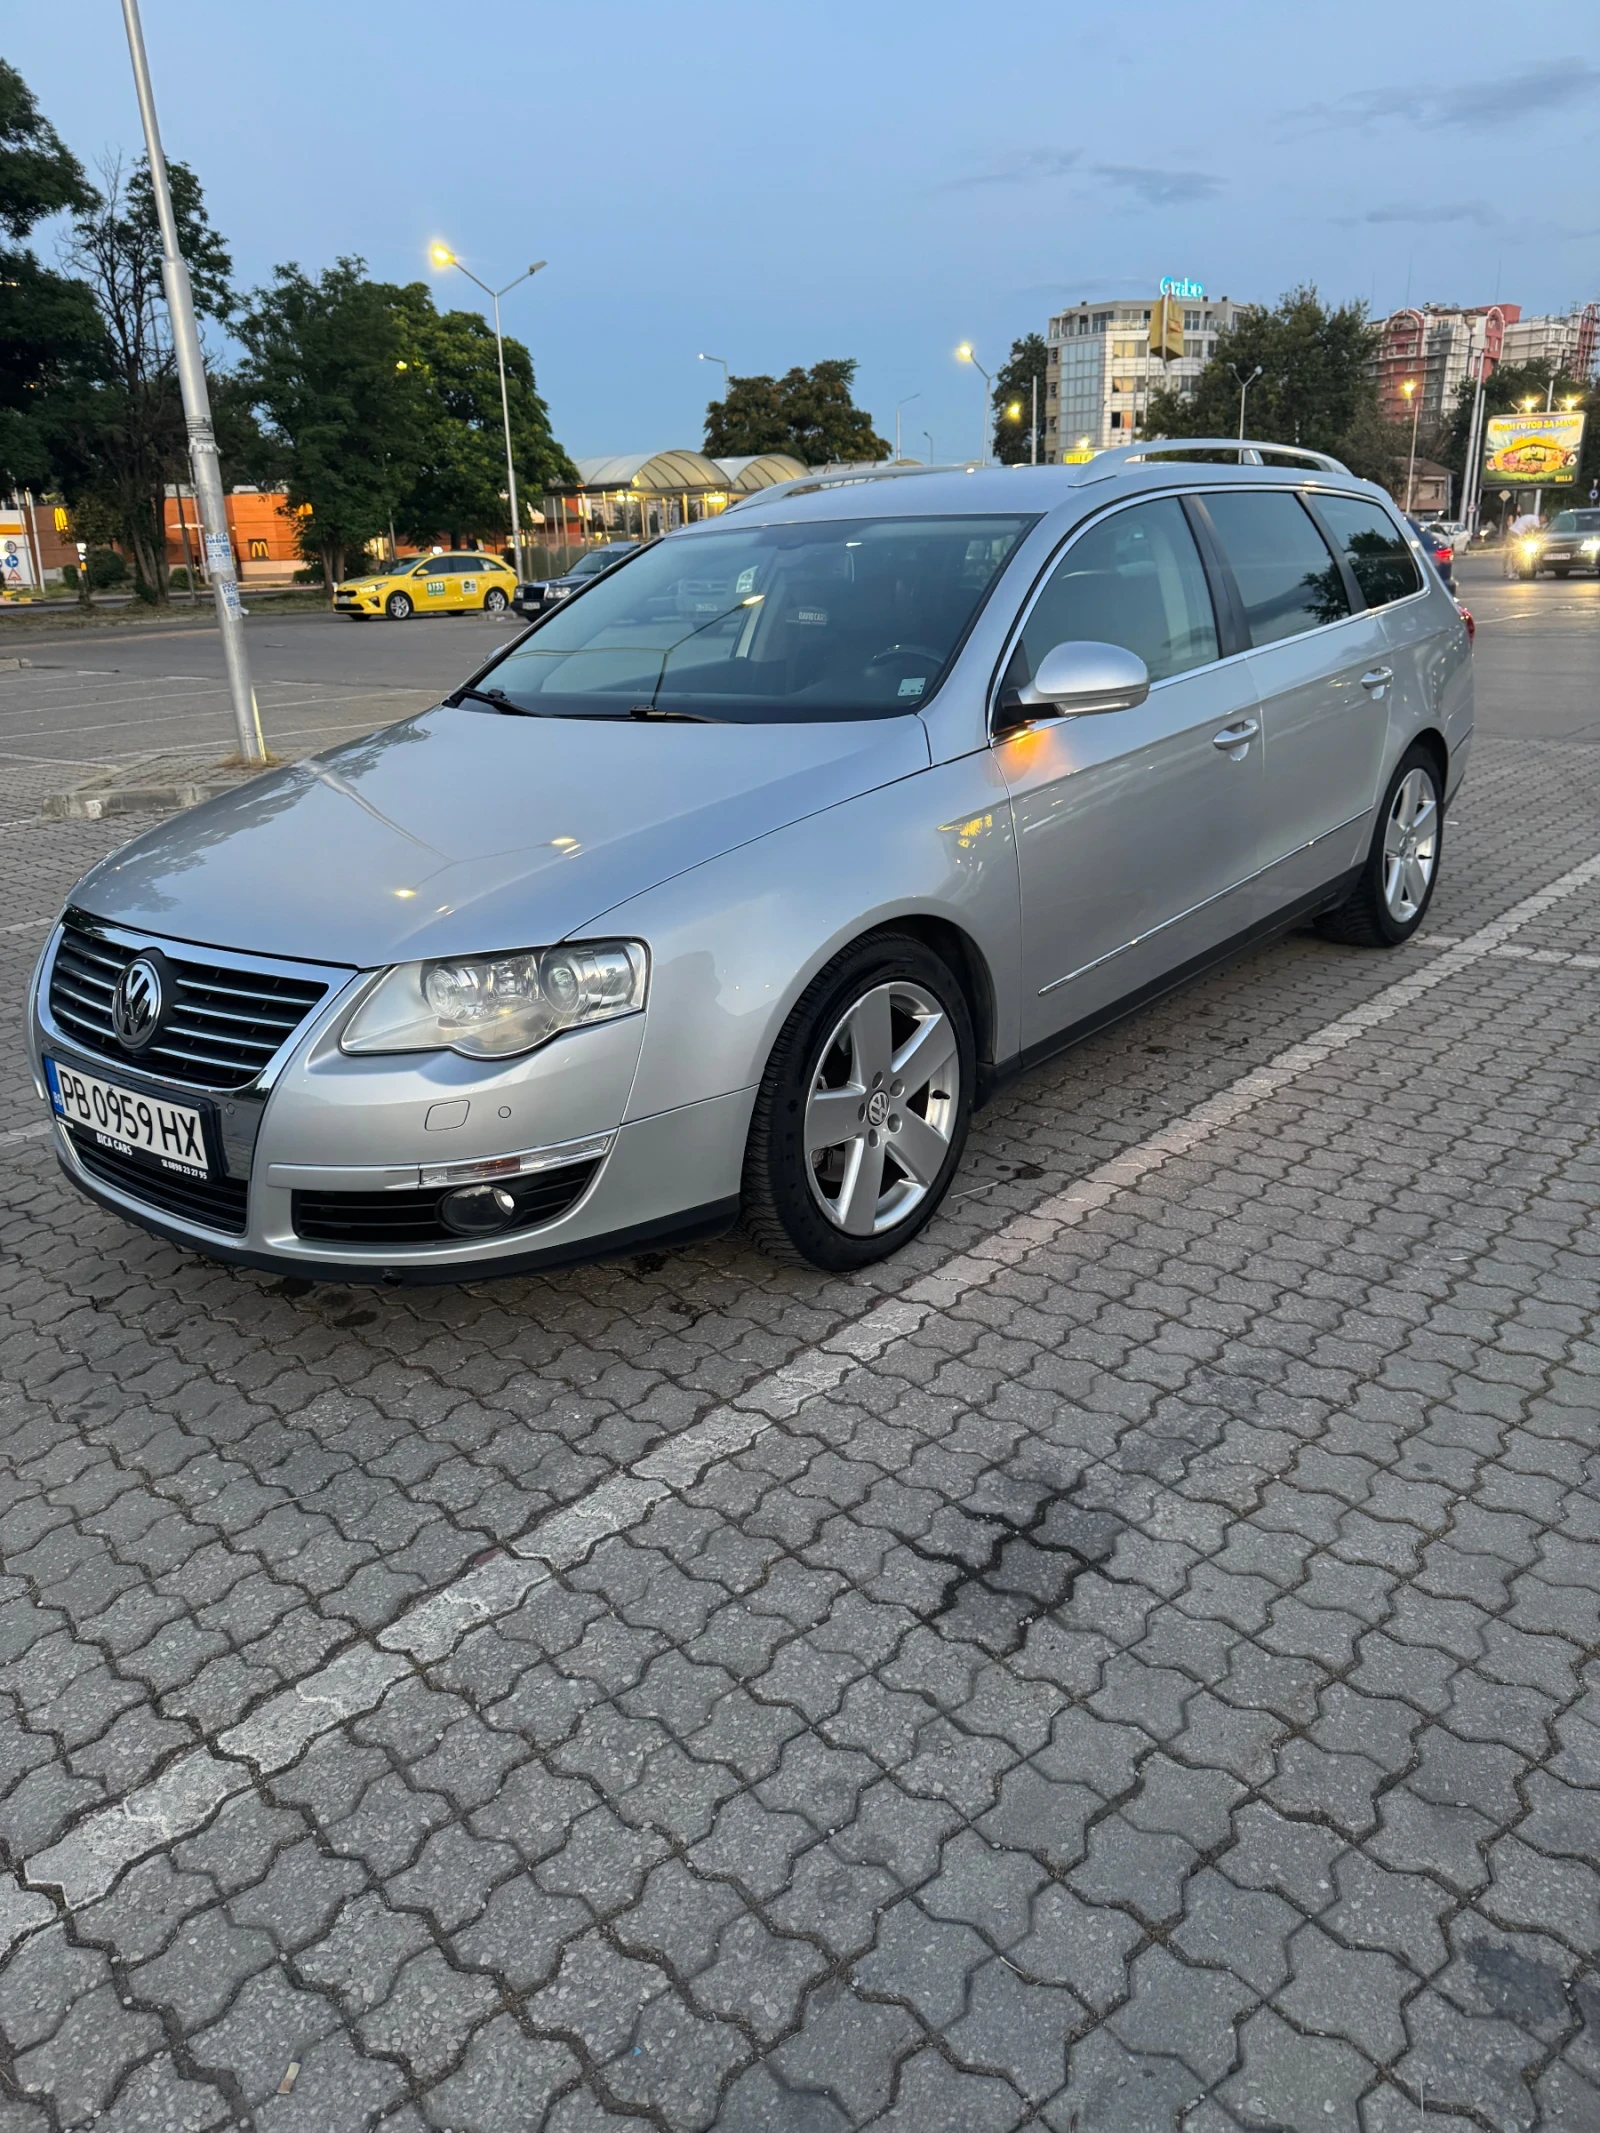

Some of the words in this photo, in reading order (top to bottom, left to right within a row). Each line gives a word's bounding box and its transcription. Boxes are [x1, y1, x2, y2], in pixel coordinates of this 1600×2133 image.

[1517, 420, 1542, 430] ГОТОВ
[1543, 420, 1555, 429] ЗА
[59, 1069, 91, 1120] PB
[92, 1085, 153, 1146] 0959
[157, 1107, 203, 1161] HX
[96, 1132, 113, 1148] BICA
[113, 1139, 133, 1156] CARS
